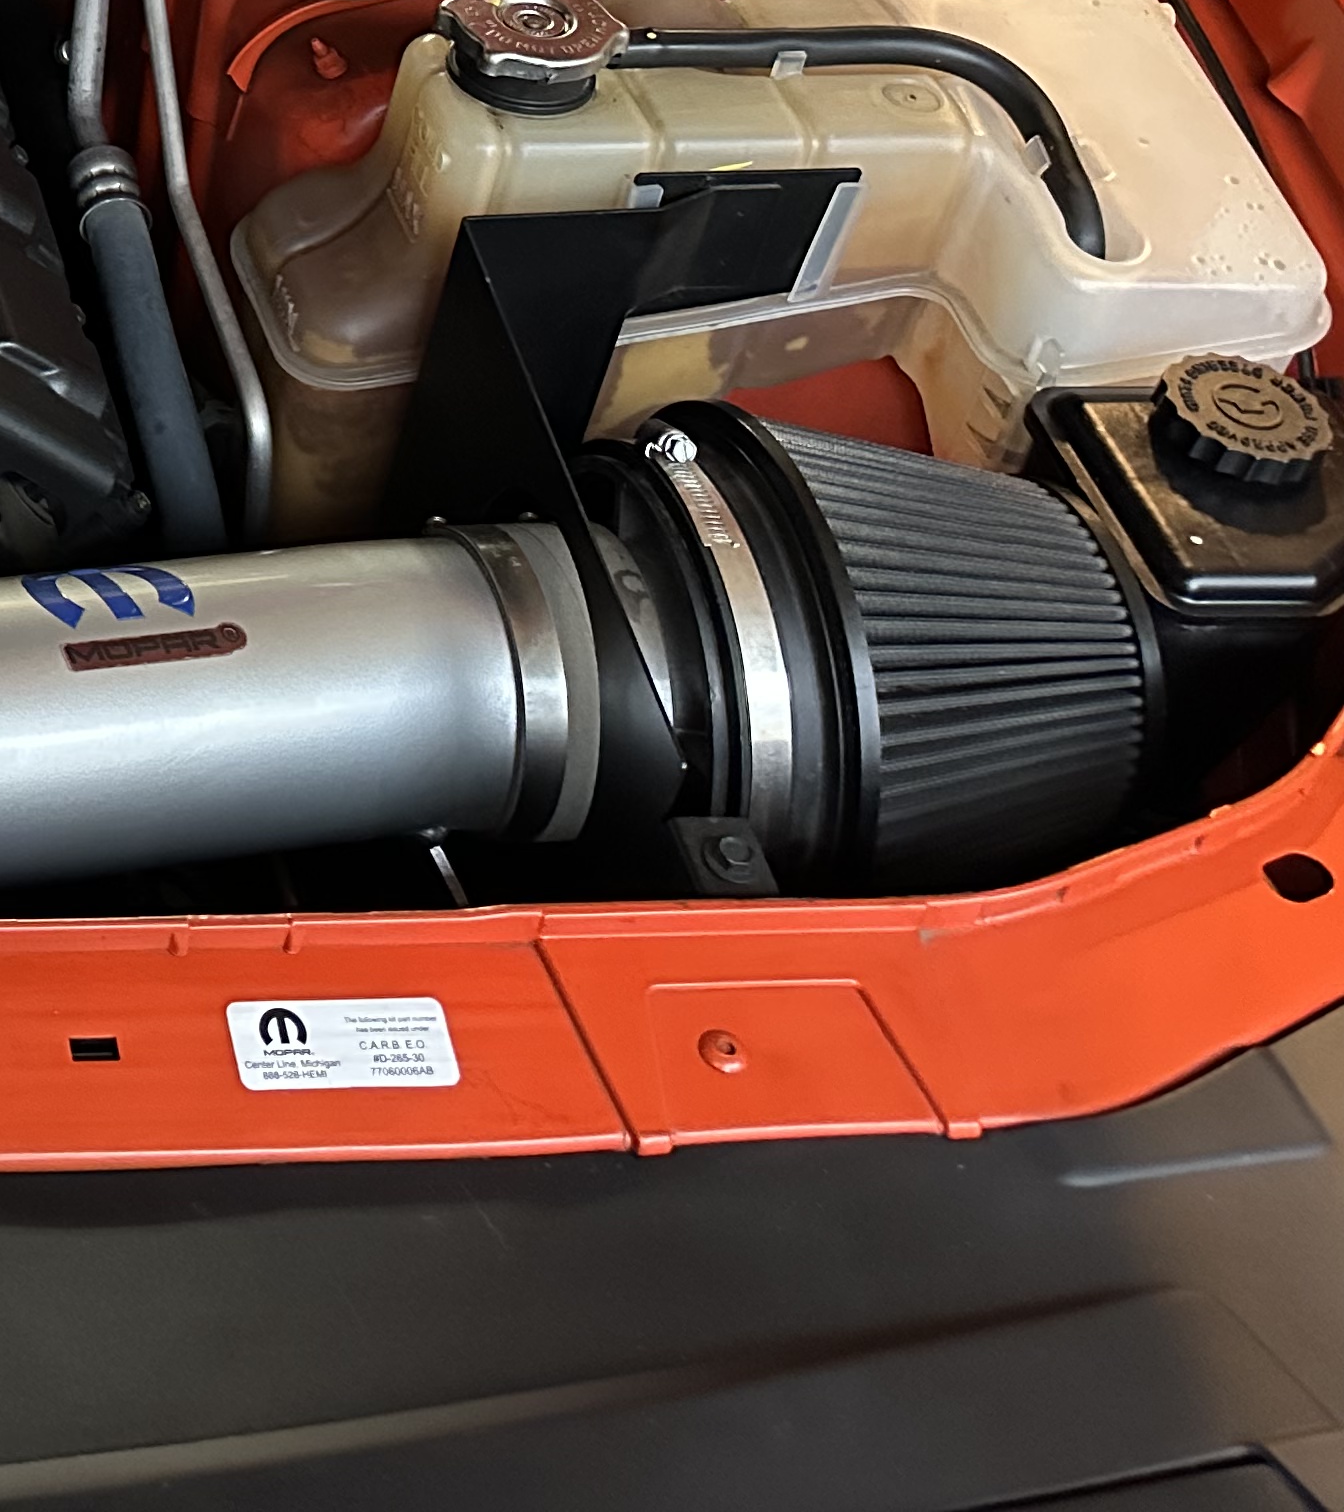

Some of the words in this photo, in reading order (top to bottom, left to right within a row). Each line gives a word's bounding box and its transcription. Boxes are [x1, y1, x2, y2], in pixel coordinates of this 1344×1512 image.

[263, 1048, 311, 1056] MOPAR
[244, 1060, 274, 1069] Center
[300, 1059, 341, 1069] Michigan
